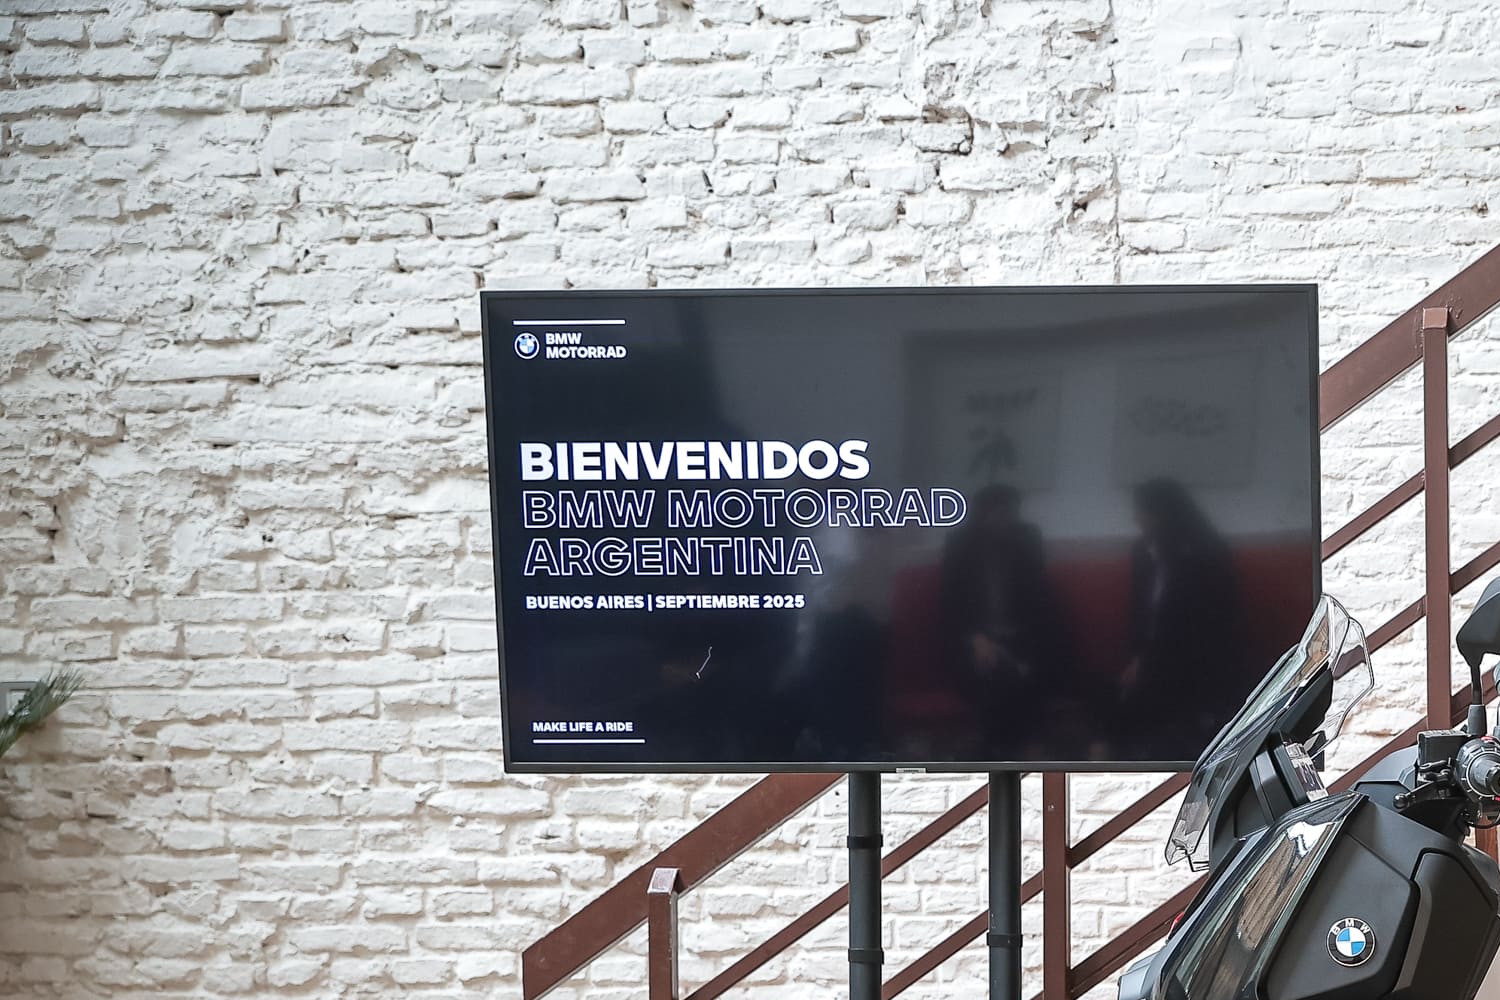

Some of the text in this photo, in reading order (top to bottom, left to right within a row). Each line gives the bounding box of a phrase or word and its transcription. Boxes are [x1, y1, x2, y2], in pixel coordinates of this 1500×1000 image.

[546, 333, 582, 344] BMW
[546, 346, 627, 358] MOTORRAD
[520, 440, 870, 481] BIENVENIDOS
[523, 489, 967, 528] BMW MOTORRAD
[523, 537, 823, 576] ARGENTINA
[526, 596, 594, 609] BUENOS
[596, 596, 645, 609] AIRES
[655, 595, 760, 608] SEPTIEMBRE
[763, 595, 805, 608] 2025
[532, 721, 633, 732] MAKE LIFE A RIDE
